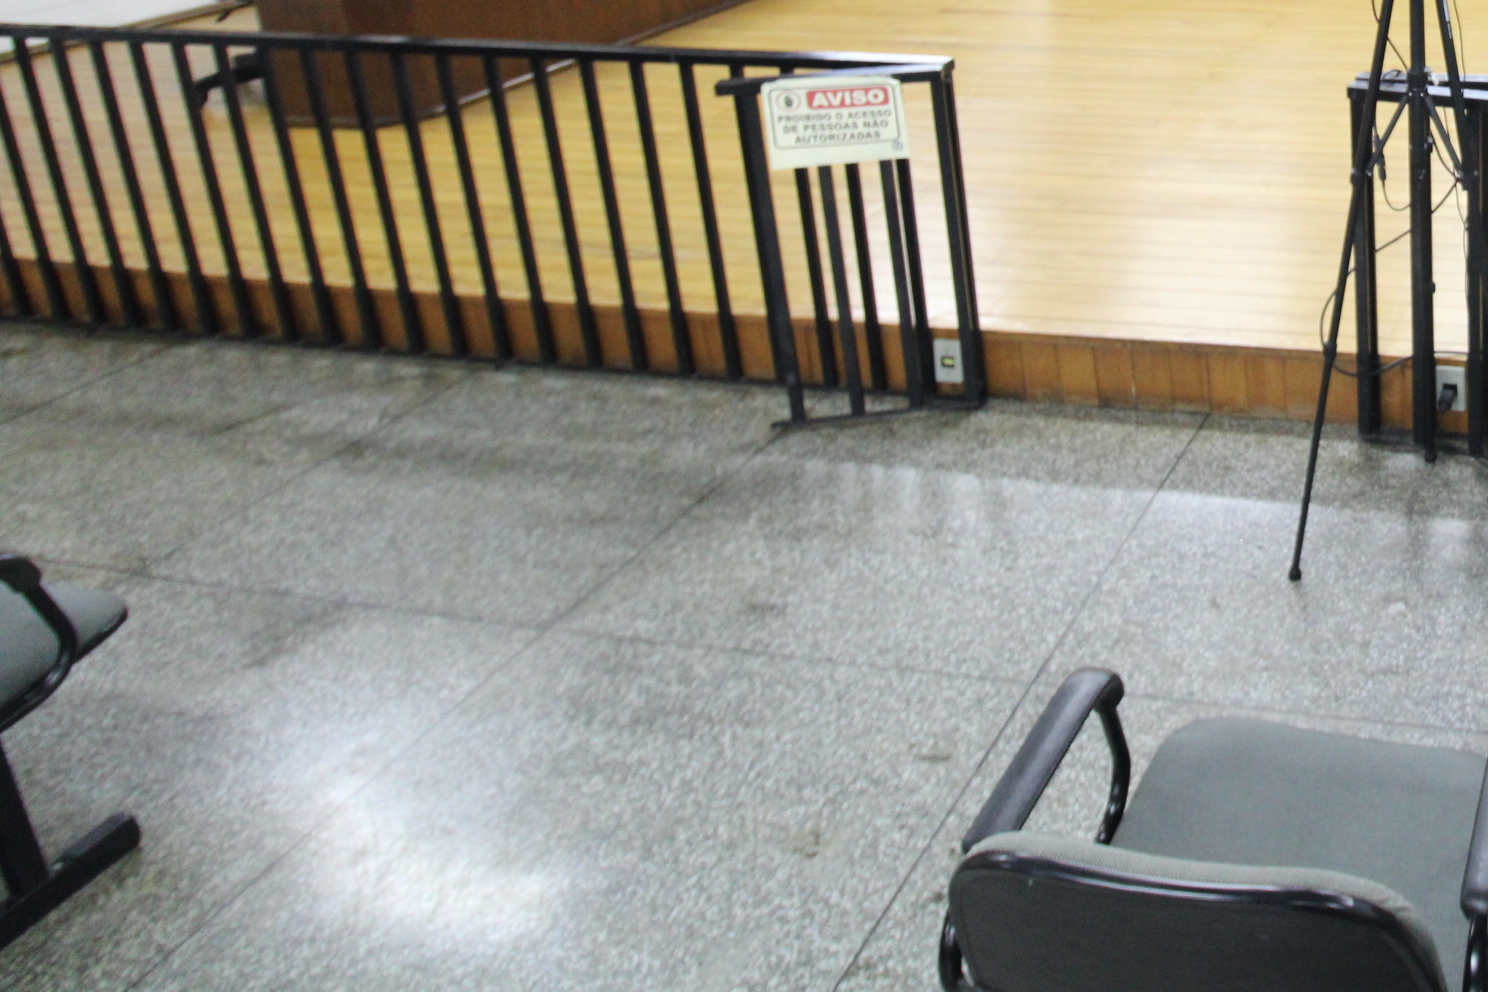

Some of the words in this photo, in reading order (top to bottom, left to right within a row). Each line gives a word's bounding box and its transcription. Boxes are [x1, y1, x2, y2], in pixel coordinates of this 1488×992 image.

[812, 89, 885, 108] AVISO
[777, 113, 831, 123] PROIBIDO
[847, 109, 892, 119] ACESSO
[782, 124, 798, 134] DE
[803, 122, 859, 132] PESSOAS
[862, 118, 889, 128] NÃO
[794, 130, 881, 145] AUTORIZADAS
